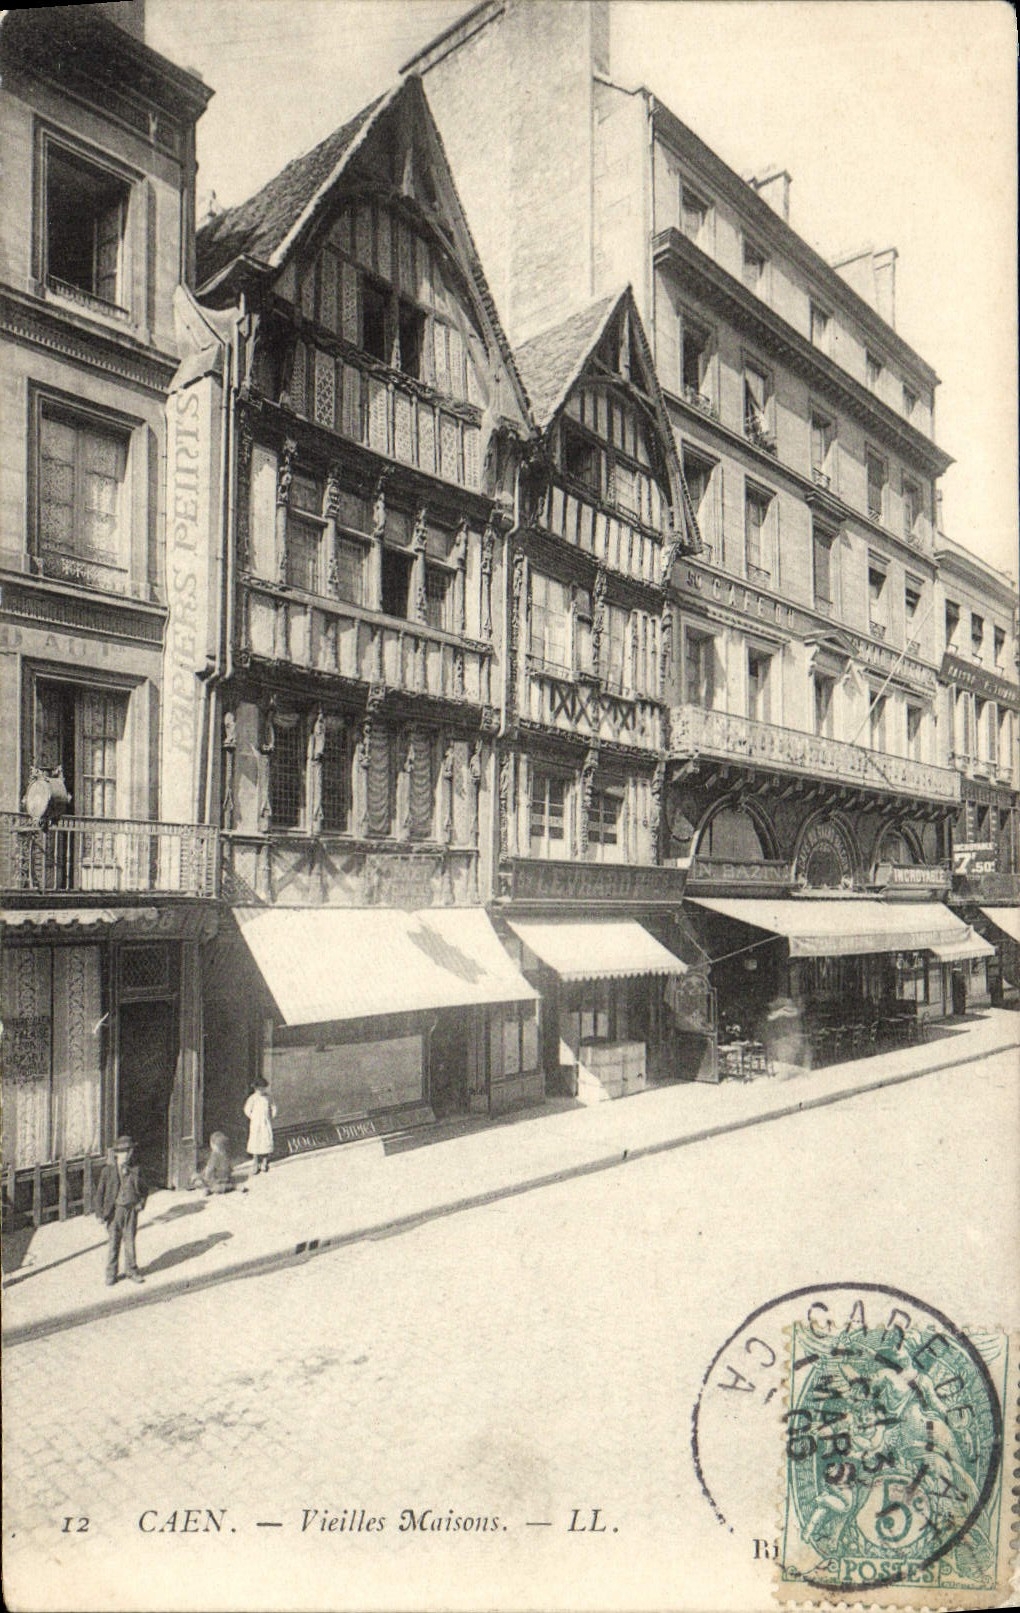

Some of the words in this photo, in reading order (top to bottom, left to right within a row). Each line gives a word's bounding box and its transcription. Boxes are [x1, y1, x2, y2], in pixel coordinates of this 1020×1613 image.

[174, 392, 200, 555] PEINTS
[169, 571, 199, 756] PAPIERS
[893, 868, 946, 883] INCROYABLE
[842, 1559, 936, 1583] POSTES
